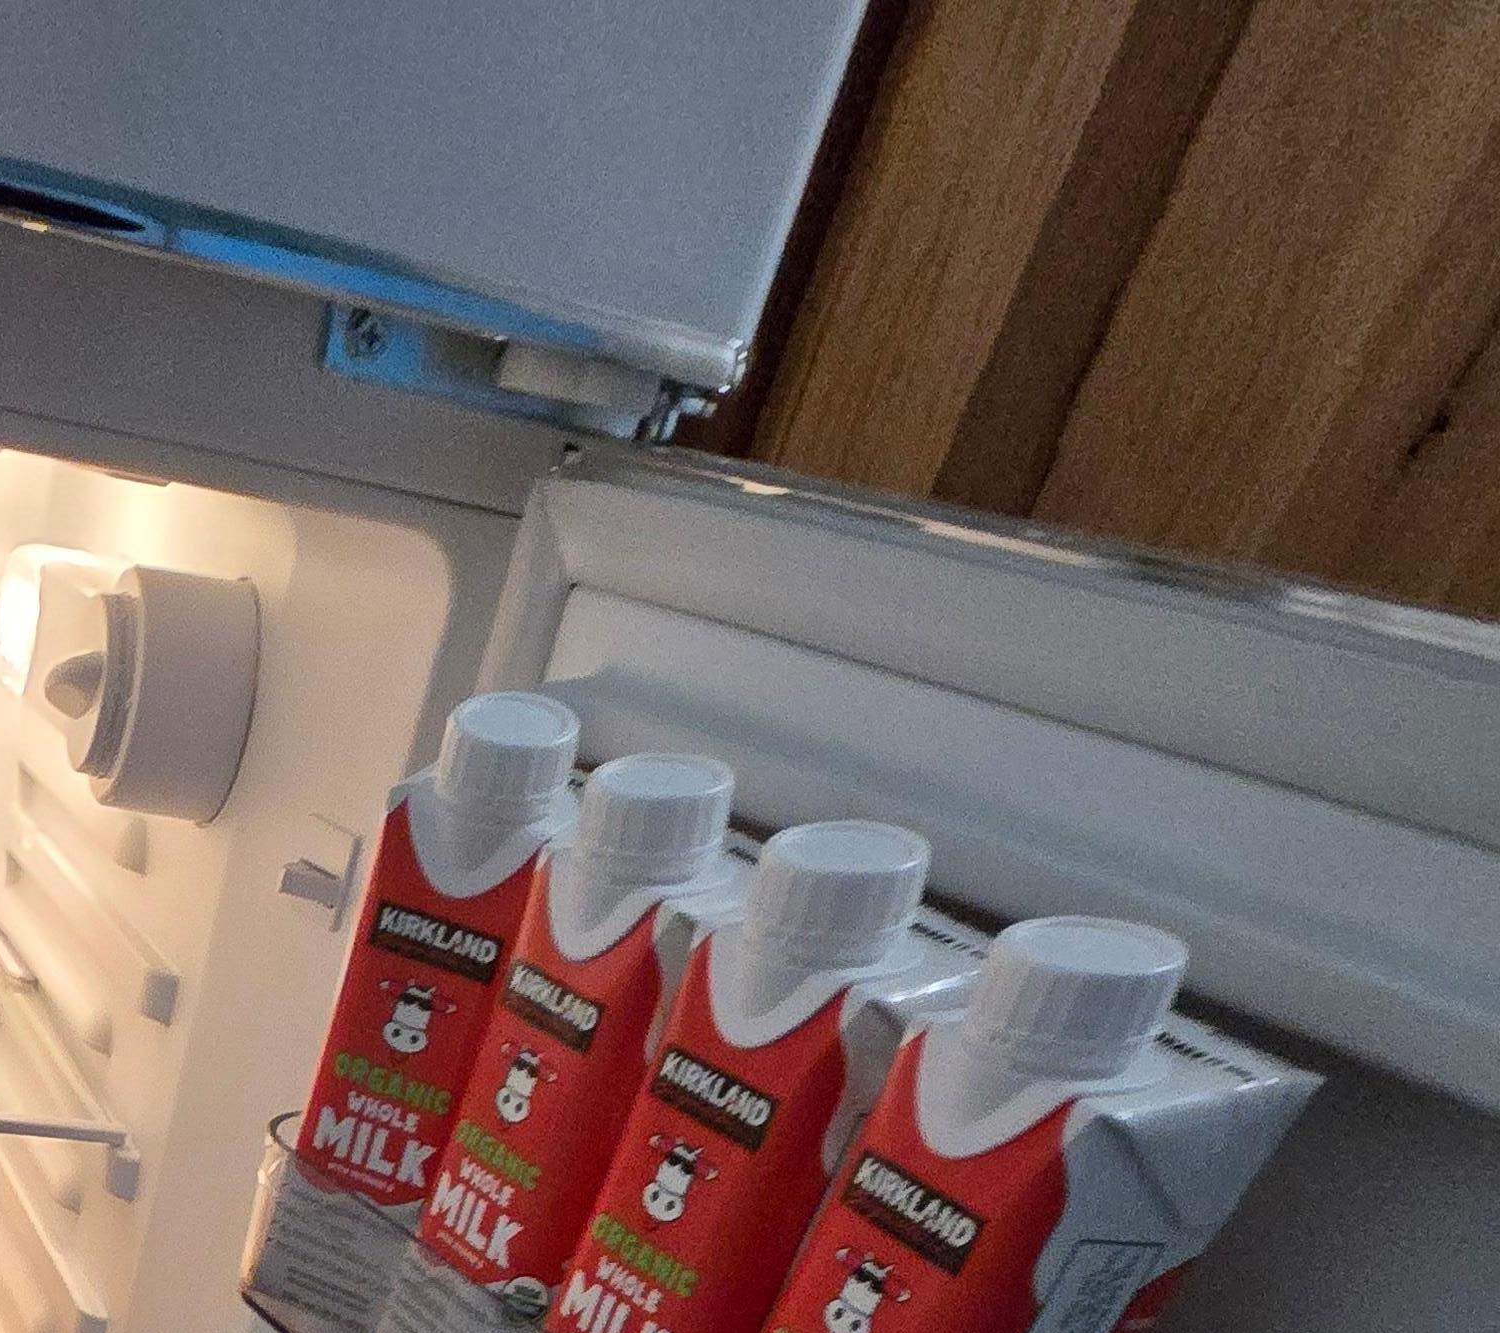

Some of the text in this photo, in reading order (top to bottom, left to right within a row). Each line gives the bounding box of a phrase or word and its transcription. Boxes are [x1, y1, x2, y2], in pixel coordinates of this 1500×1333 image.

[378, 906, 499, 965] KIRKLAND
[509, 964, 598, 1032] KIRKLAND
[348, 1090, 420, 1134] WHOLE
[658, 1050, 773, 1127] KIRKLAND
[312, 1104, 438, 1189] MILK
[430, 1170, 525, 1270] MILK
[853, 1156, 977, 1249] KIRKLAND
[595, 1256, 664, 1314] WHOLE
